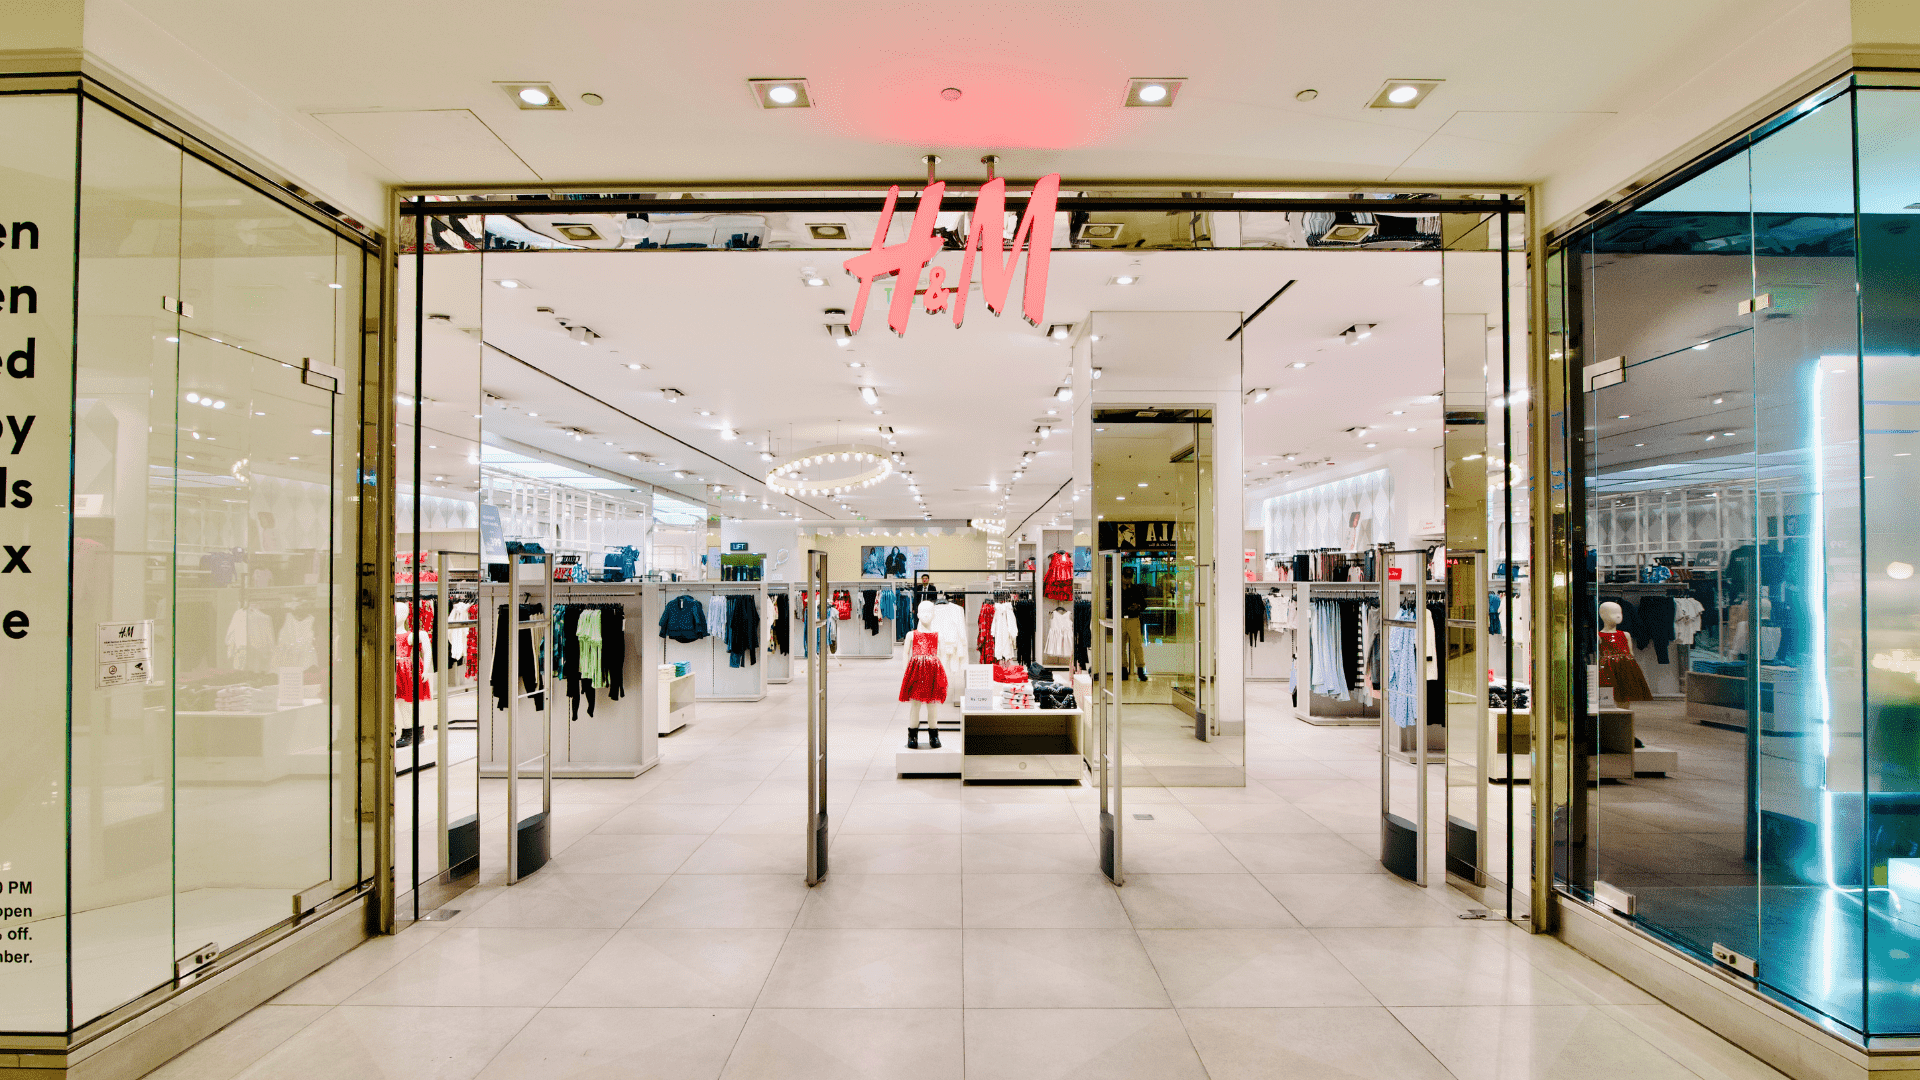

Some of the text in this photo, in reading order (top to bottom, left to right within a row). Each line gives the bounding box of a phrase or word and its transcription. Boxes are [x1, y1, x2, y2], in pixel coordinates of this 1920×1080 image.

[0, 221, 39, 249] n
[842, 172, 1061, 338] H&M
[0, 285, 37, 314] n
[0, 337, 36, 379] d
[0, 415, 36, 455] y
[8, 881, 32, 894] PM
[0, 907, 32, 920] pen
[7, 927, 32, 941] off.
[0, 950, 32, 963] ber.
